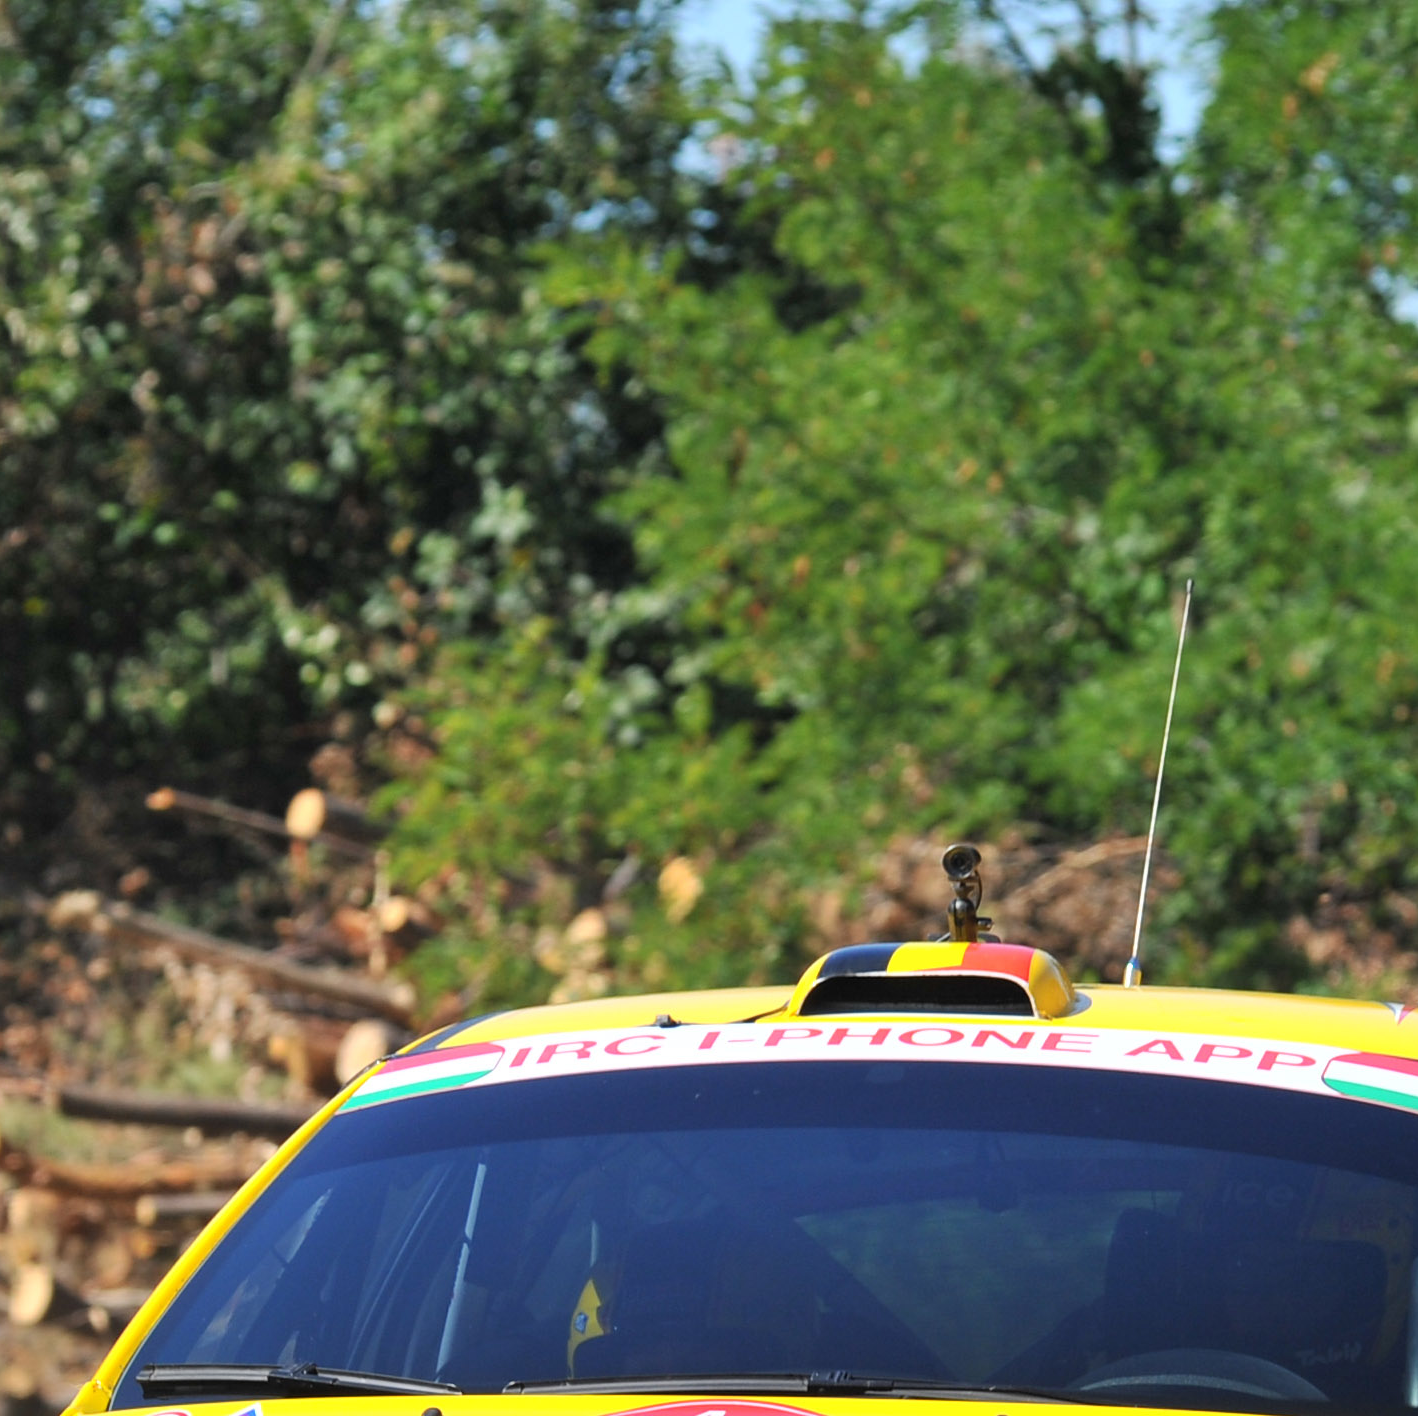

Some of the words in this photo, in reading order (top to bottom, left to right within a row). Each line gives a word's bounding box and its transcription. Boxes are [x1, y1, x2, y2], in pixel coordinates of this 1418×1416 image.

[509, 1034, 666, 1067] IRC
[698, 1027, 1098, 1053] I-PHONE
[1126, 1038, 1316, 1072] APP
